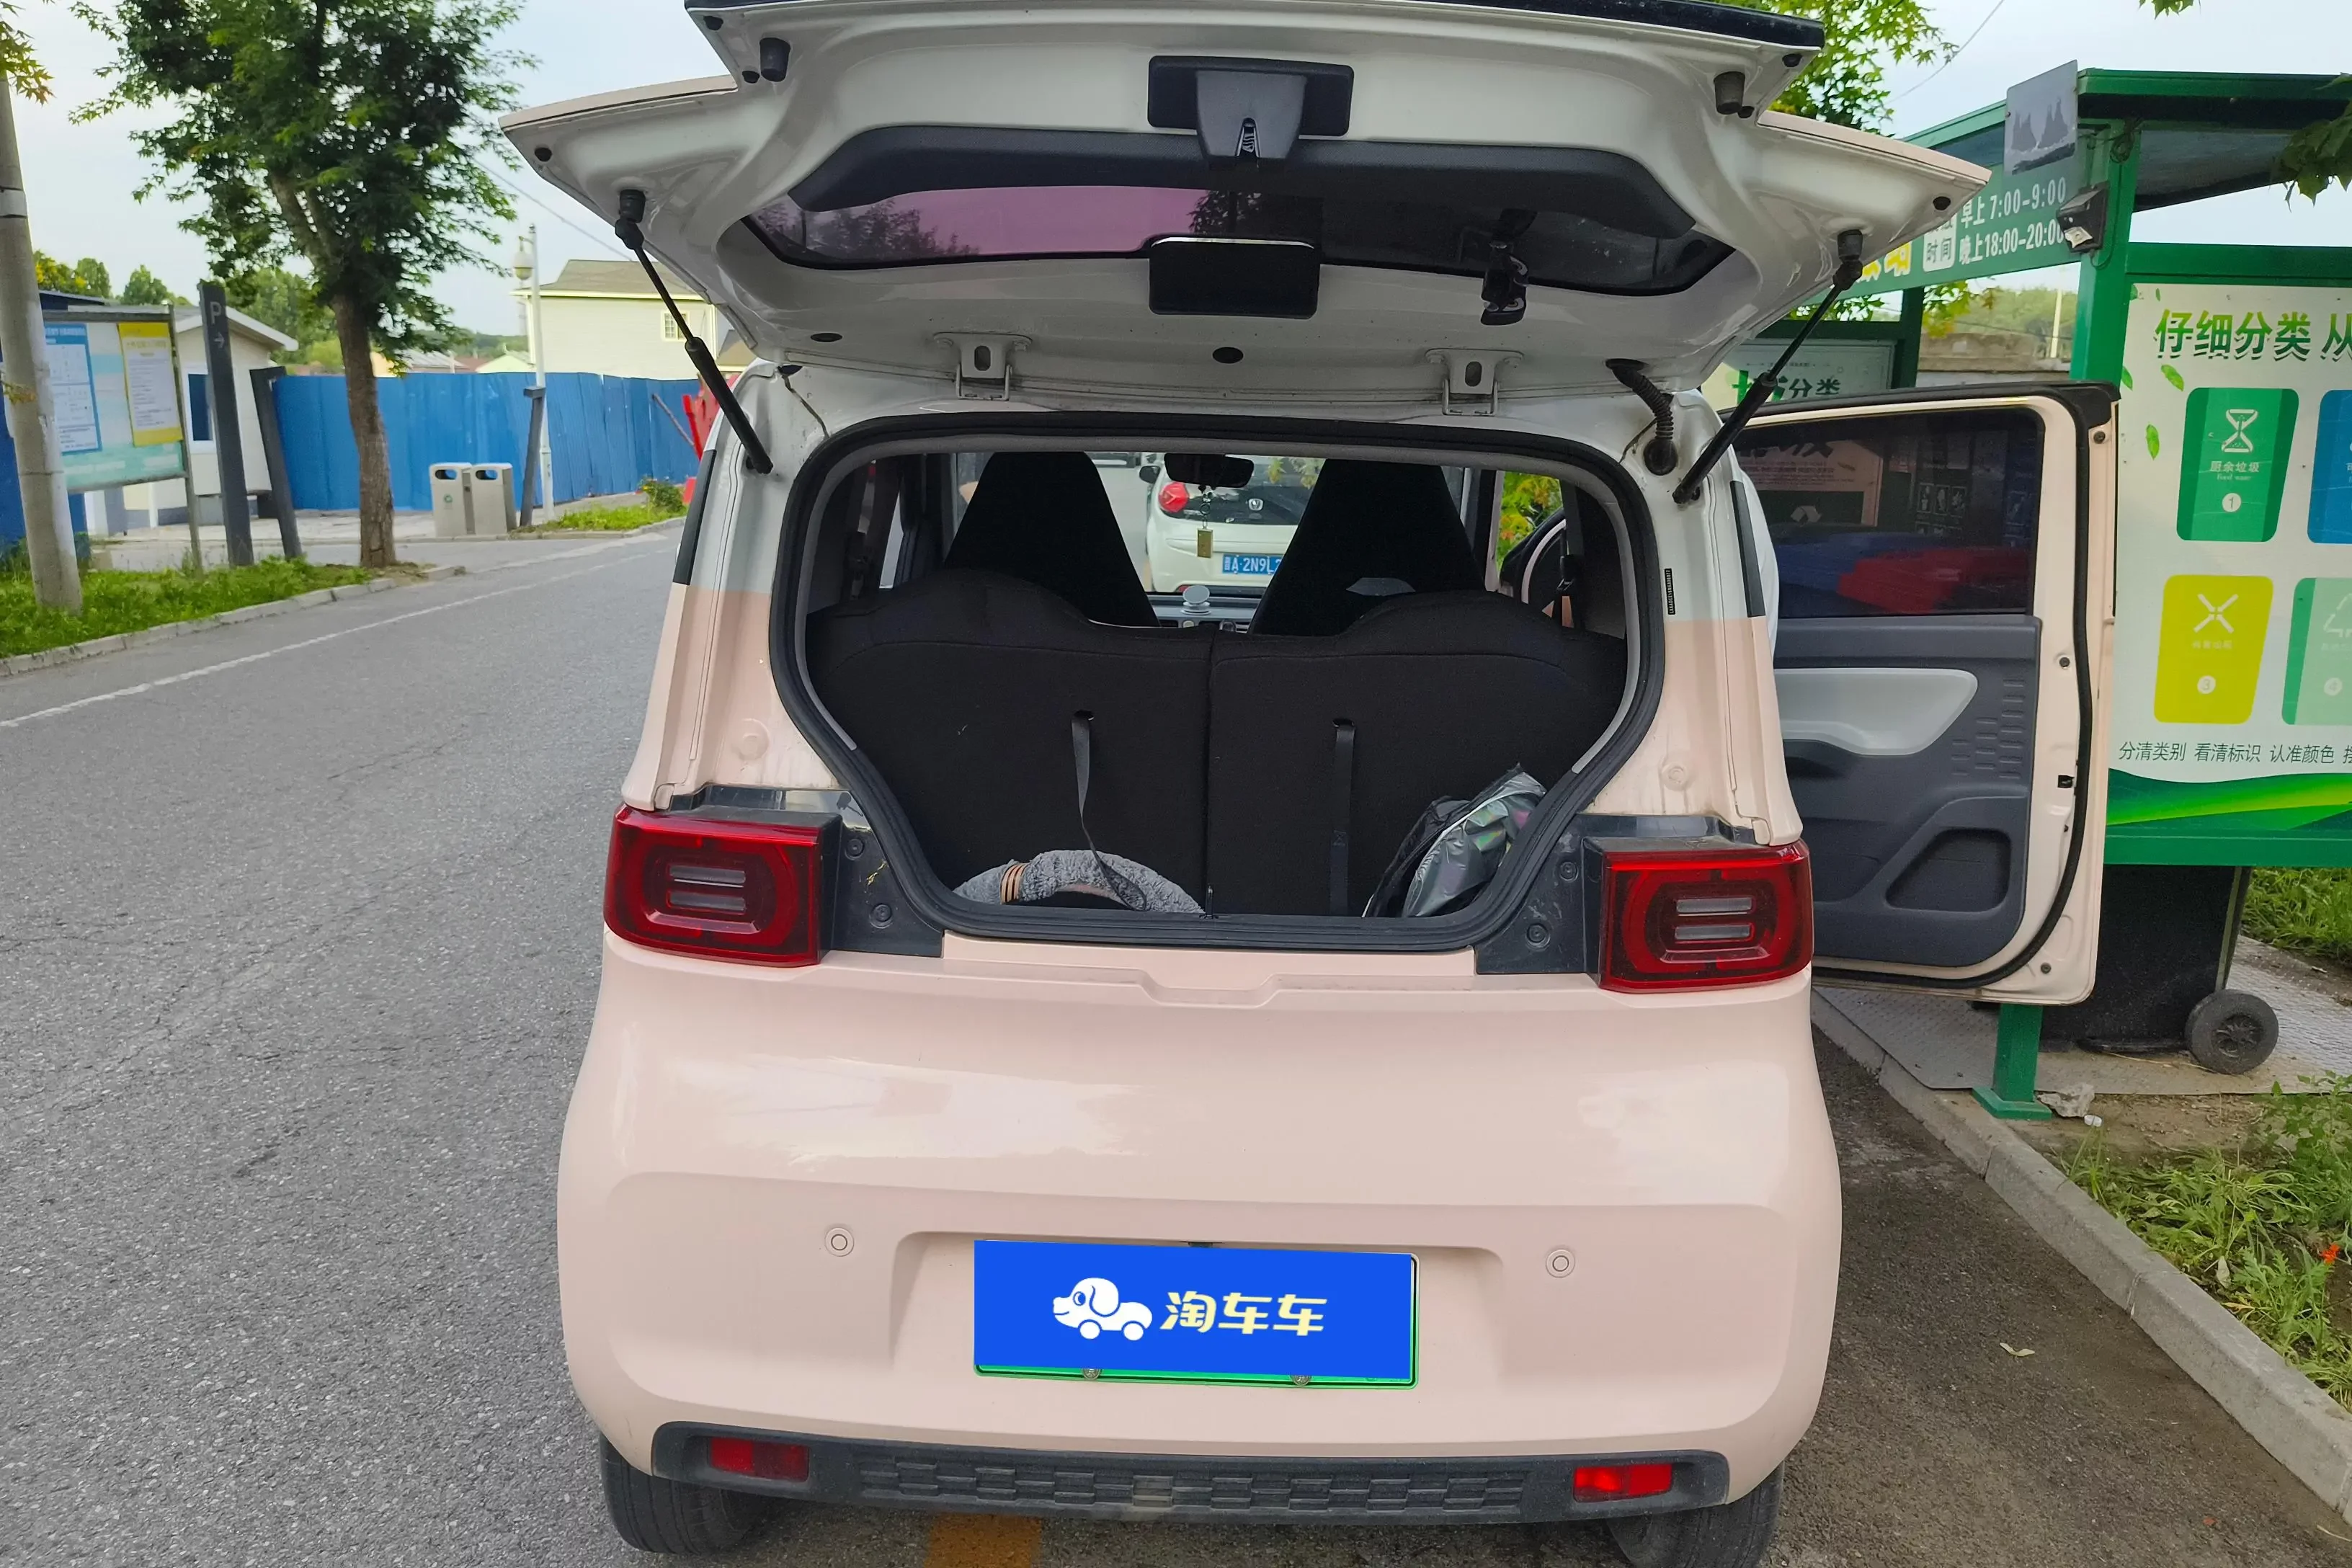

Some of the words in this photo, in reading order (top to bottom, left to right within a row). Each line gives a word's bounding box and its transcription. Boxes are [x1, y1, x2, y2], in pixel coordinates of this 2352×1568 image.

[1990, 177, 2067, 220] 7:00-9:00
[210, 301, 222, 324] P
[2154, 309, 2310, 360] 仔细分类
[2119, 741, 2187, 761] 分清类别
[2194, 743, 2261, 762] 看清标识
[2269, 744, 2335, 764] 认准颜色
